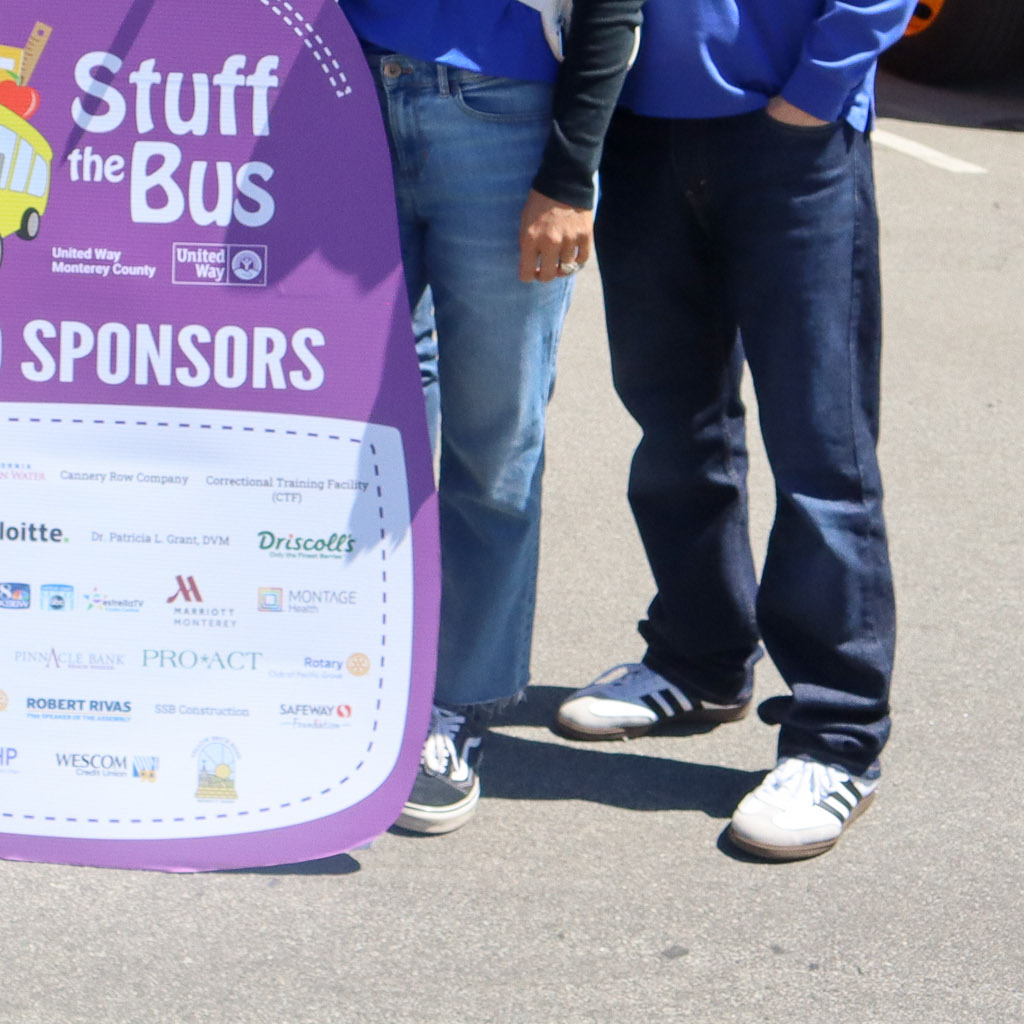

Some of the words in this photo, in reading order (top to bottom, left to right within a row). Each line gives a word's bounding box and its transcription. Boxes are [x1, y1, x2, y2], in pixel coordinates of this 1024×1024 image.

[71, 50, 280, 136] Stuff
[67, 146, 125, 183] the
[130, 140, 275, 227] Bus
[52, 247, 92, 259] United
[94, 248, 121, 262] Way
[176, 247, 225, 263] United
[52, 262, 110, 277] Monterey
[112, 263, 156, 278] County
[195, 263, 225, 282] Way
[20, 319, 326, 392] SPONSORS
[10, 469, 47, 480] WATER
[60, 470, 107, 483] Cannery
[109, 471, 134, 482] Row
[136, 473, 189, 486] Company
[206, 475, 273, 487] Correctional
[276, 477, 324, 491] Training
[328, 479, 369, 493] Facility
[272, 492, 303, 504] (CTF)
[91, 532, 107, 543] Dr.
[110, 532, 152, 545] Patricia
[155, 533, 164, 544] L.
[167, 534, 200, 547] Grant,
[203, 535, 230, 546] DVM
[257, 530, 356, 553] Driscoll's
[0, 584, 12, 600] 8
[288, 590, 357, 604] MONTAGE
[174, 607, 234, 616] MARRIOTT
[174, 619, 237, 628] MONTEREY
[14, 647, 83, 668] PINNACLE
[88, 653, 125, 665] BANK
[304, 657, 343, 671] Rotary
[26, 698, 86, 711] ROBERT
[89, 700, 132, 713] RIVAS
[155, 704, 176, 714] SSB
[179, 705, 250, 717] Construction
[280, 704, 334, 716] SAFEWAY
[56, 753, 127, 769] WESCOM
